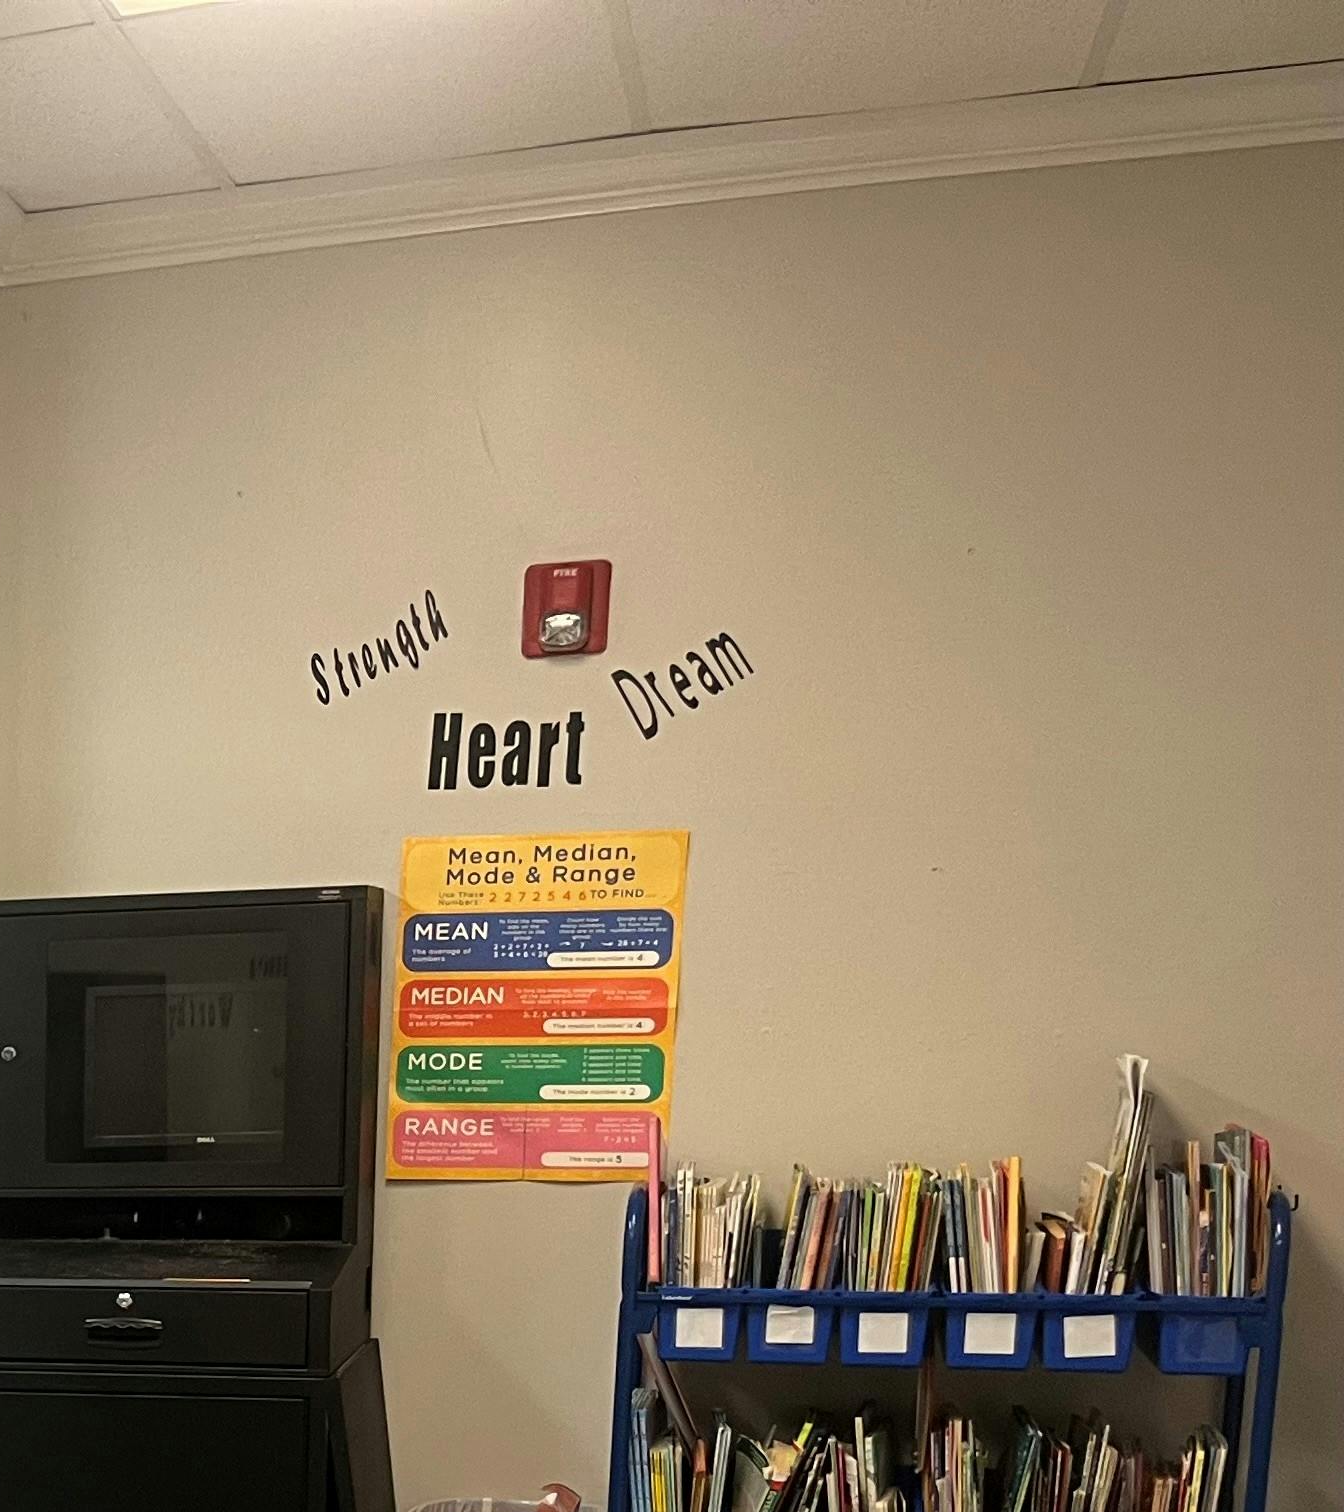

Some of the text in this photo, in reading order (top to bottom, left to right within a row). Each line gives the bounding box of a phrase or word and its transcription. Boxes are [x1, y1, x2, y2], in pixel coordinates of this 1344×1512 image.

[311, 589, 450, 706] Strength
[610, 631, 755, 741] Dream
[427, 711, 586, 791] Heart
[448, 843, 637, 866] Mean, Median,
[446, 864, 637, 886] Mode & Range
[489, 892, 497, 903] 2
[504, 892, 512, 903] 2
[518, 892, 526, 902] 7
[532, 891, 540, 902] 2
[547, 890, 556, 901] 5
[562, 890, 571, 901] 4
[579, 890, 587, 901] 6
[590, 889, 607, 900] TO
[414, 921, 489, 941] MEAN
[410, 986, 505, 1006] MEDIAN
[408, 1052, 484, 1071] MODE
[629, 1087, 636, 1096] 2
[404, 1117, 495, 1136] RANGE
